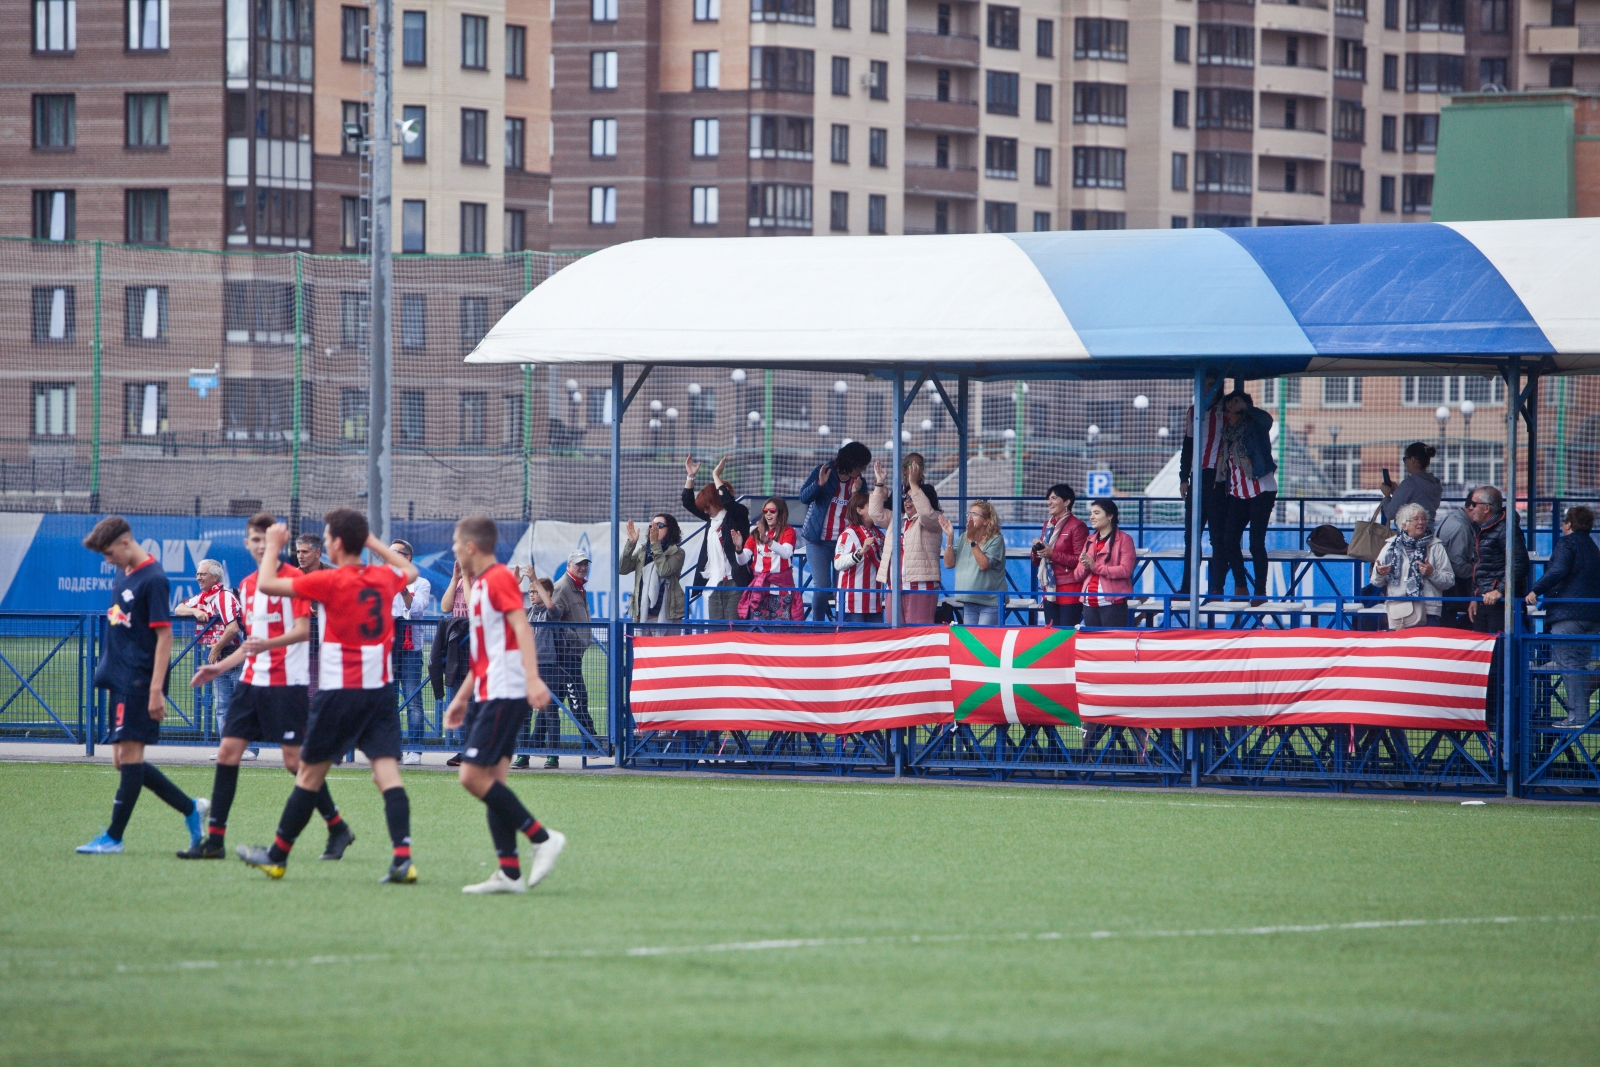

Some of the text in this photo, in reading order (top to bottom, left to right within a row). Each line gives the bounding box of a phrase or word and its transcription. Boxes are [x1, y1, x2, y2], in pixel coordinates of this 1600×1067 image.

[1093, 475, 1108, 494] P
[58, 576, 114, 592] ПОДДЕРЖК
[359, 588, 383, 638] 3
[115, 702, 125, 726] 9
